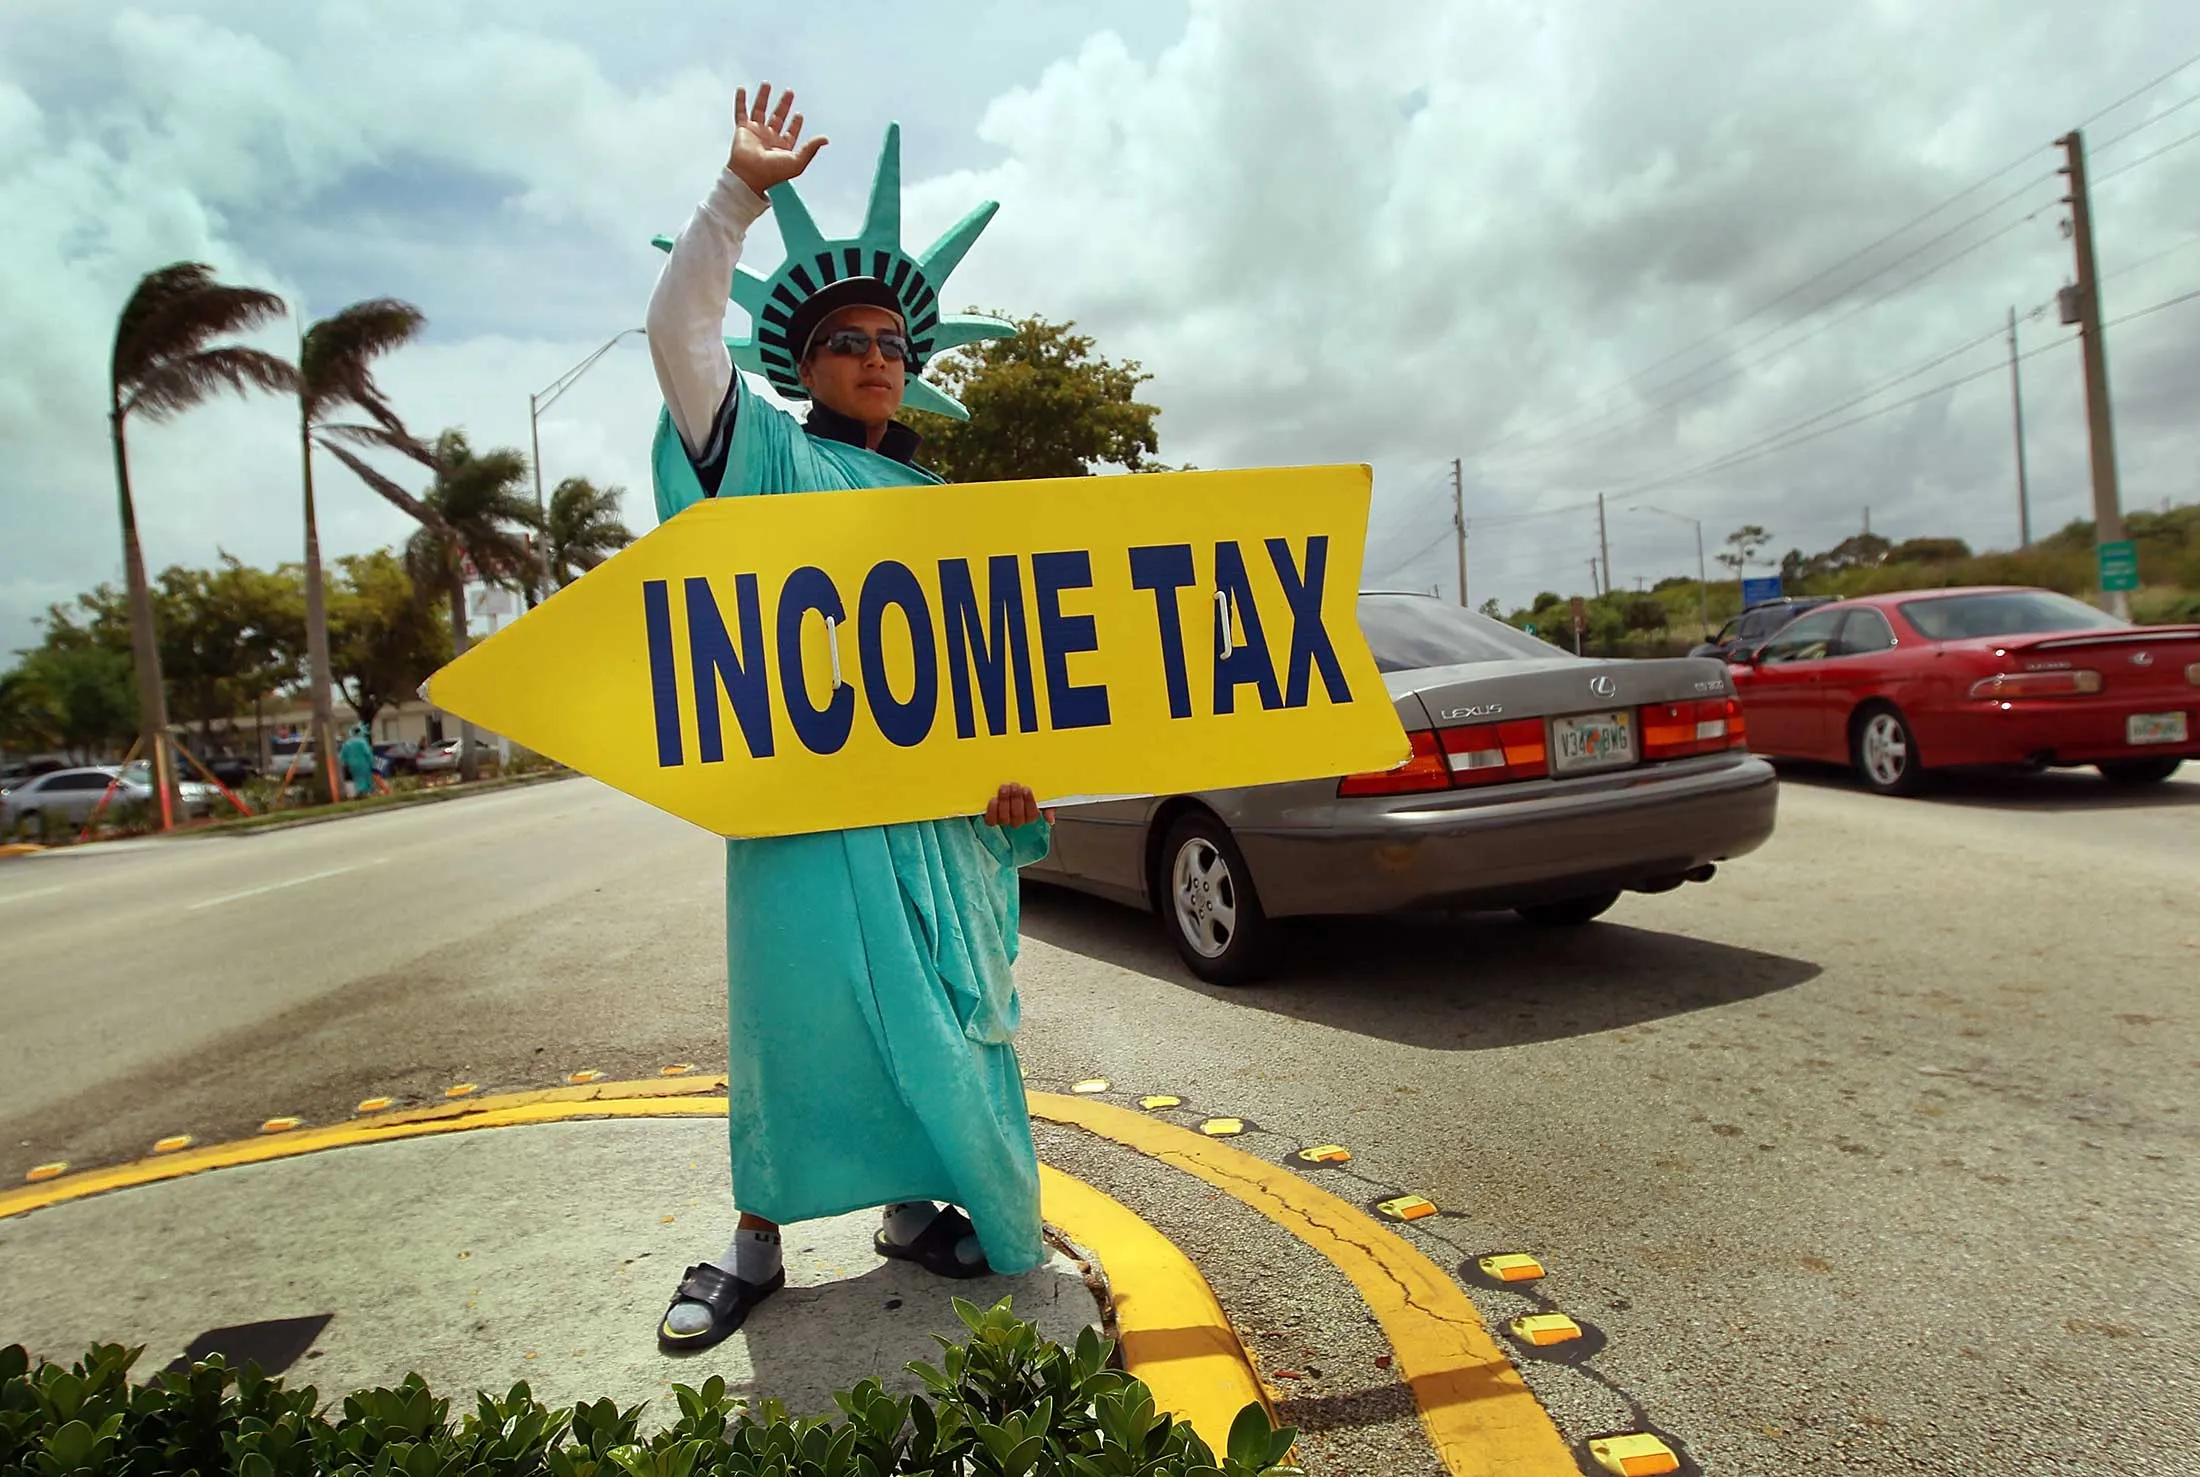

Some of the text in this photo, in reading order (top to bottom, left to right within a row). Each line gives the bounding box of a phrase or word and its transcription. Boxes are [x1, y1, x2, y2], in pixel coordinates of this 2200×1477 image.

[642, 535, 1354, 768] INCOME TAX
[1441, 703, 1503, 719] LEXUS
